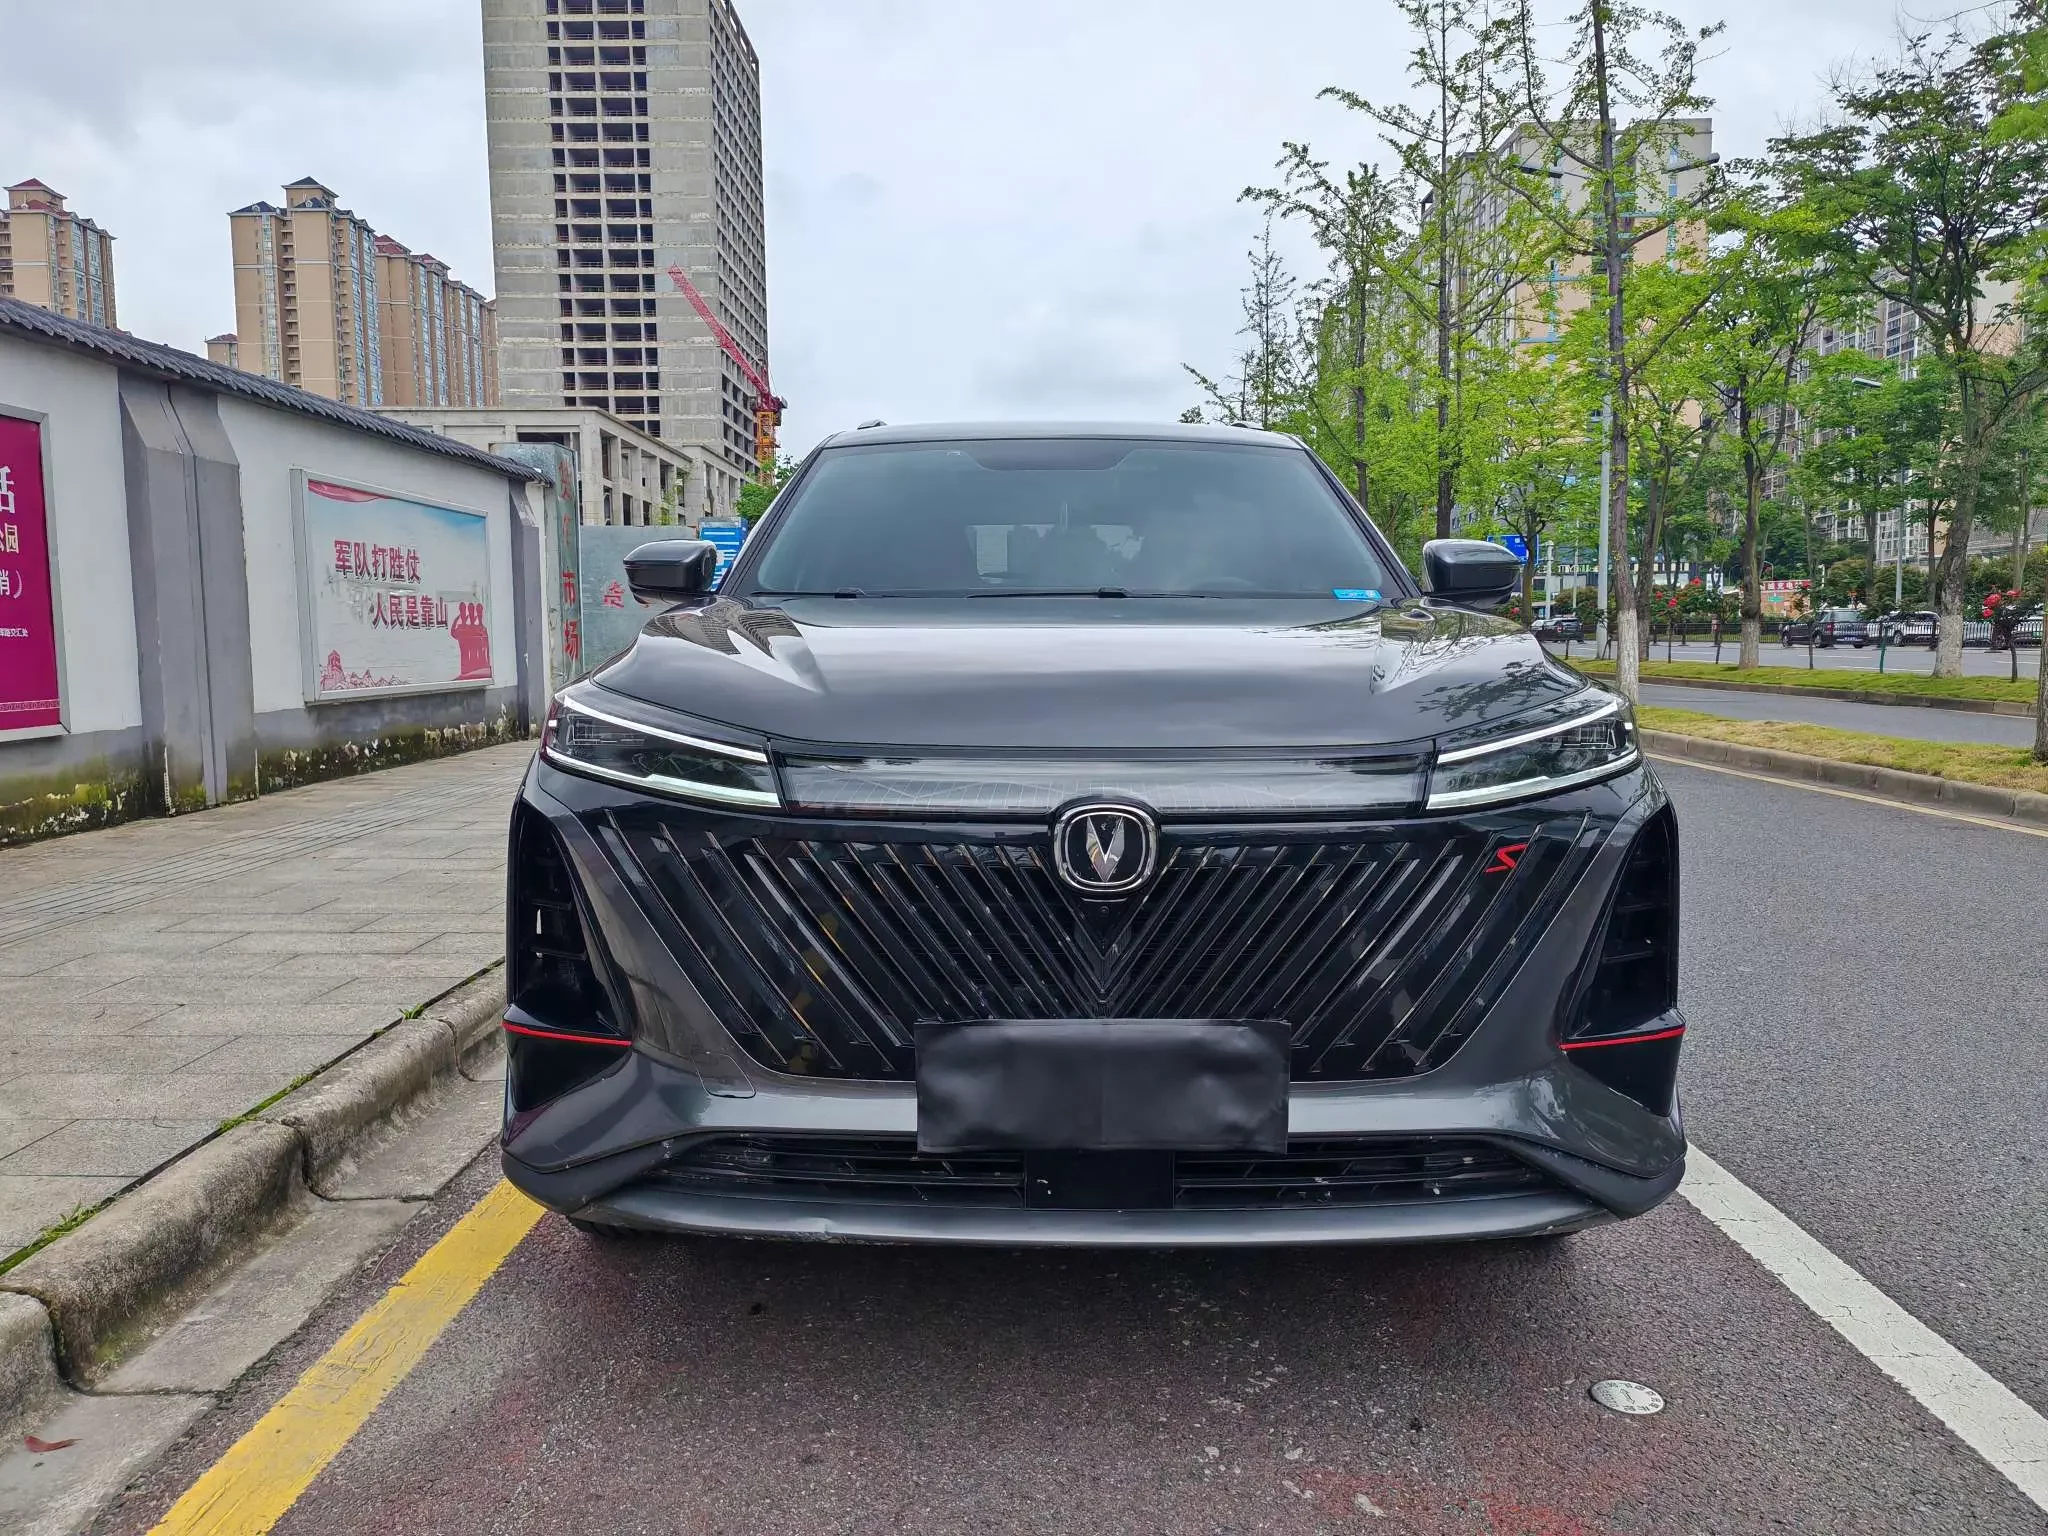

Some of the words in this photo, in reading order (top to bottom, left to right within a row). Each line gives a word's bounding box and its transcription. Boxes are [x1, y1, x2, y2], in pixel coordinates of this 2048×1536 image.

[334, 540, 422, 583] 军队打胜仗
[371, 592, 449, 629] 人民是靠山
